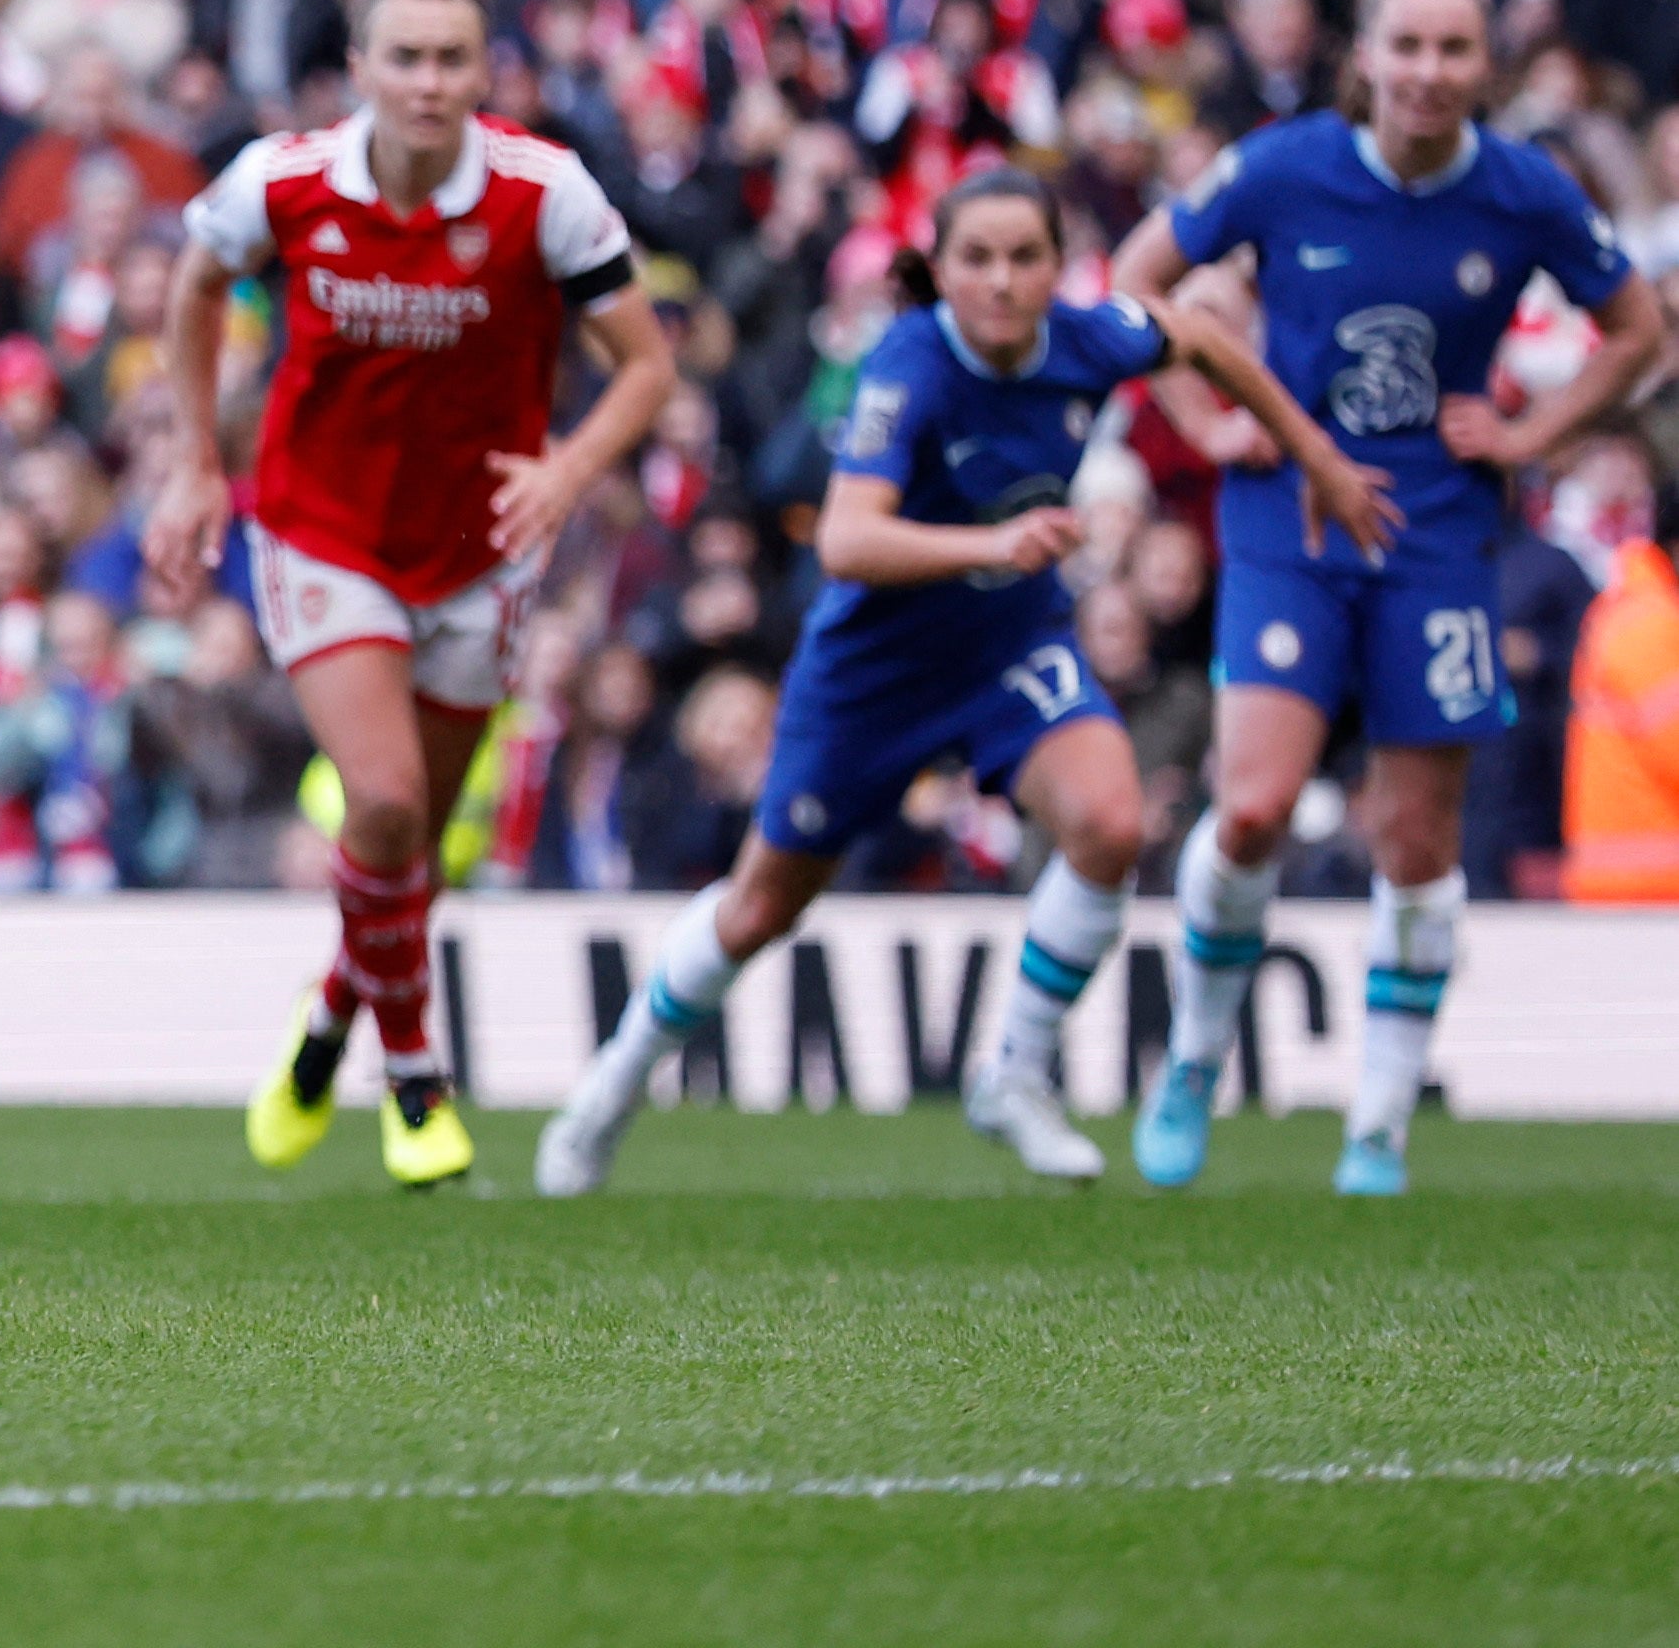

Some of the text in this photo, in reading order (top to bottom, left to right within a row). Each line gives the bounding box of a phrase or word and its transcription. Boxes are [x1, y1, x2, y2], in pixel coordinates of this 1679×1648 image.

[307, 265, 490, 323] Emirates
[1002, 644, 1080, 711] 17
[1422, 605, 1495, 701] 21
